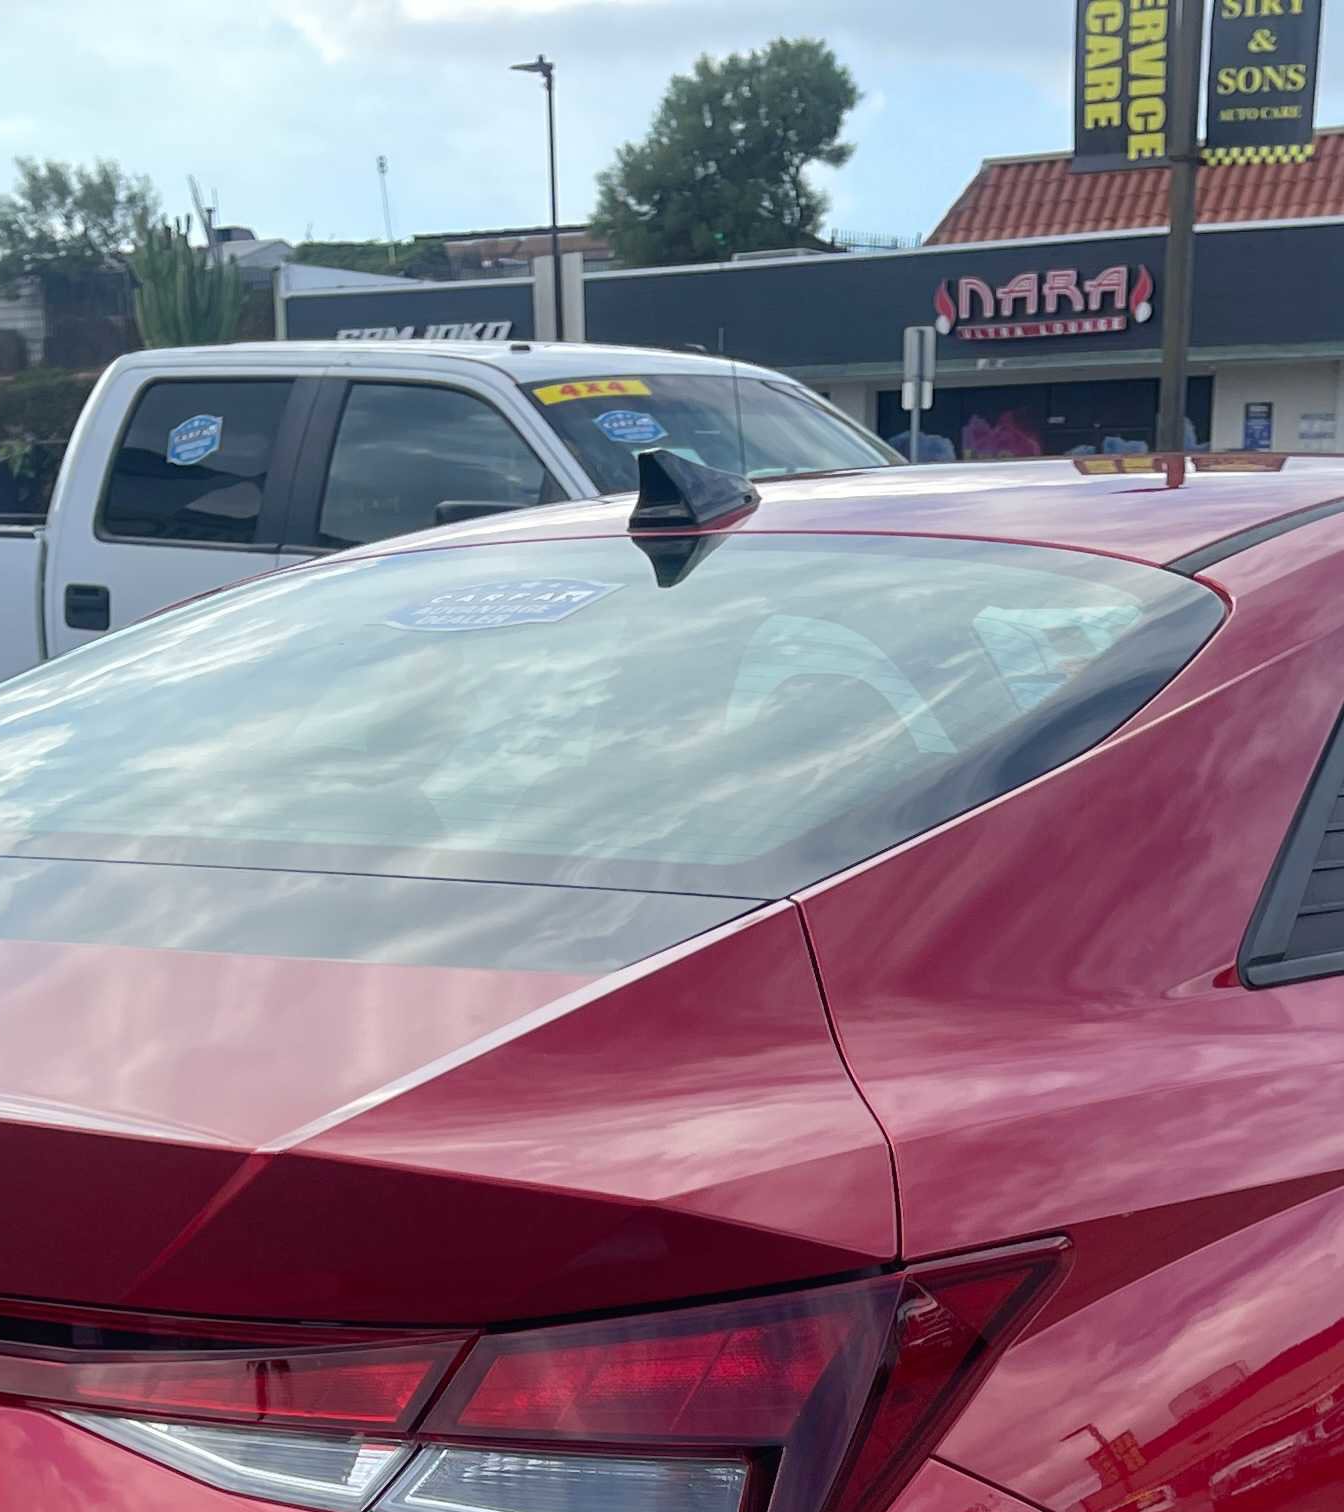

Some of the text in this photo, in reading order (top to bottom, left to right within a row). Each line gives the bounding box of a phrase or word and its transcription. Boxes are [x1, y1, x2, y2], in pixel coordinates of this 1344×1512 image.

[1084, 1, 1124, 129] CARE
[1248, 29, 1278, 53] &
[1127, 0, 1168, 160] RVICE
[1216, 64, 1307, 95] SONS
[958, 265, 1128, 319] NARA
